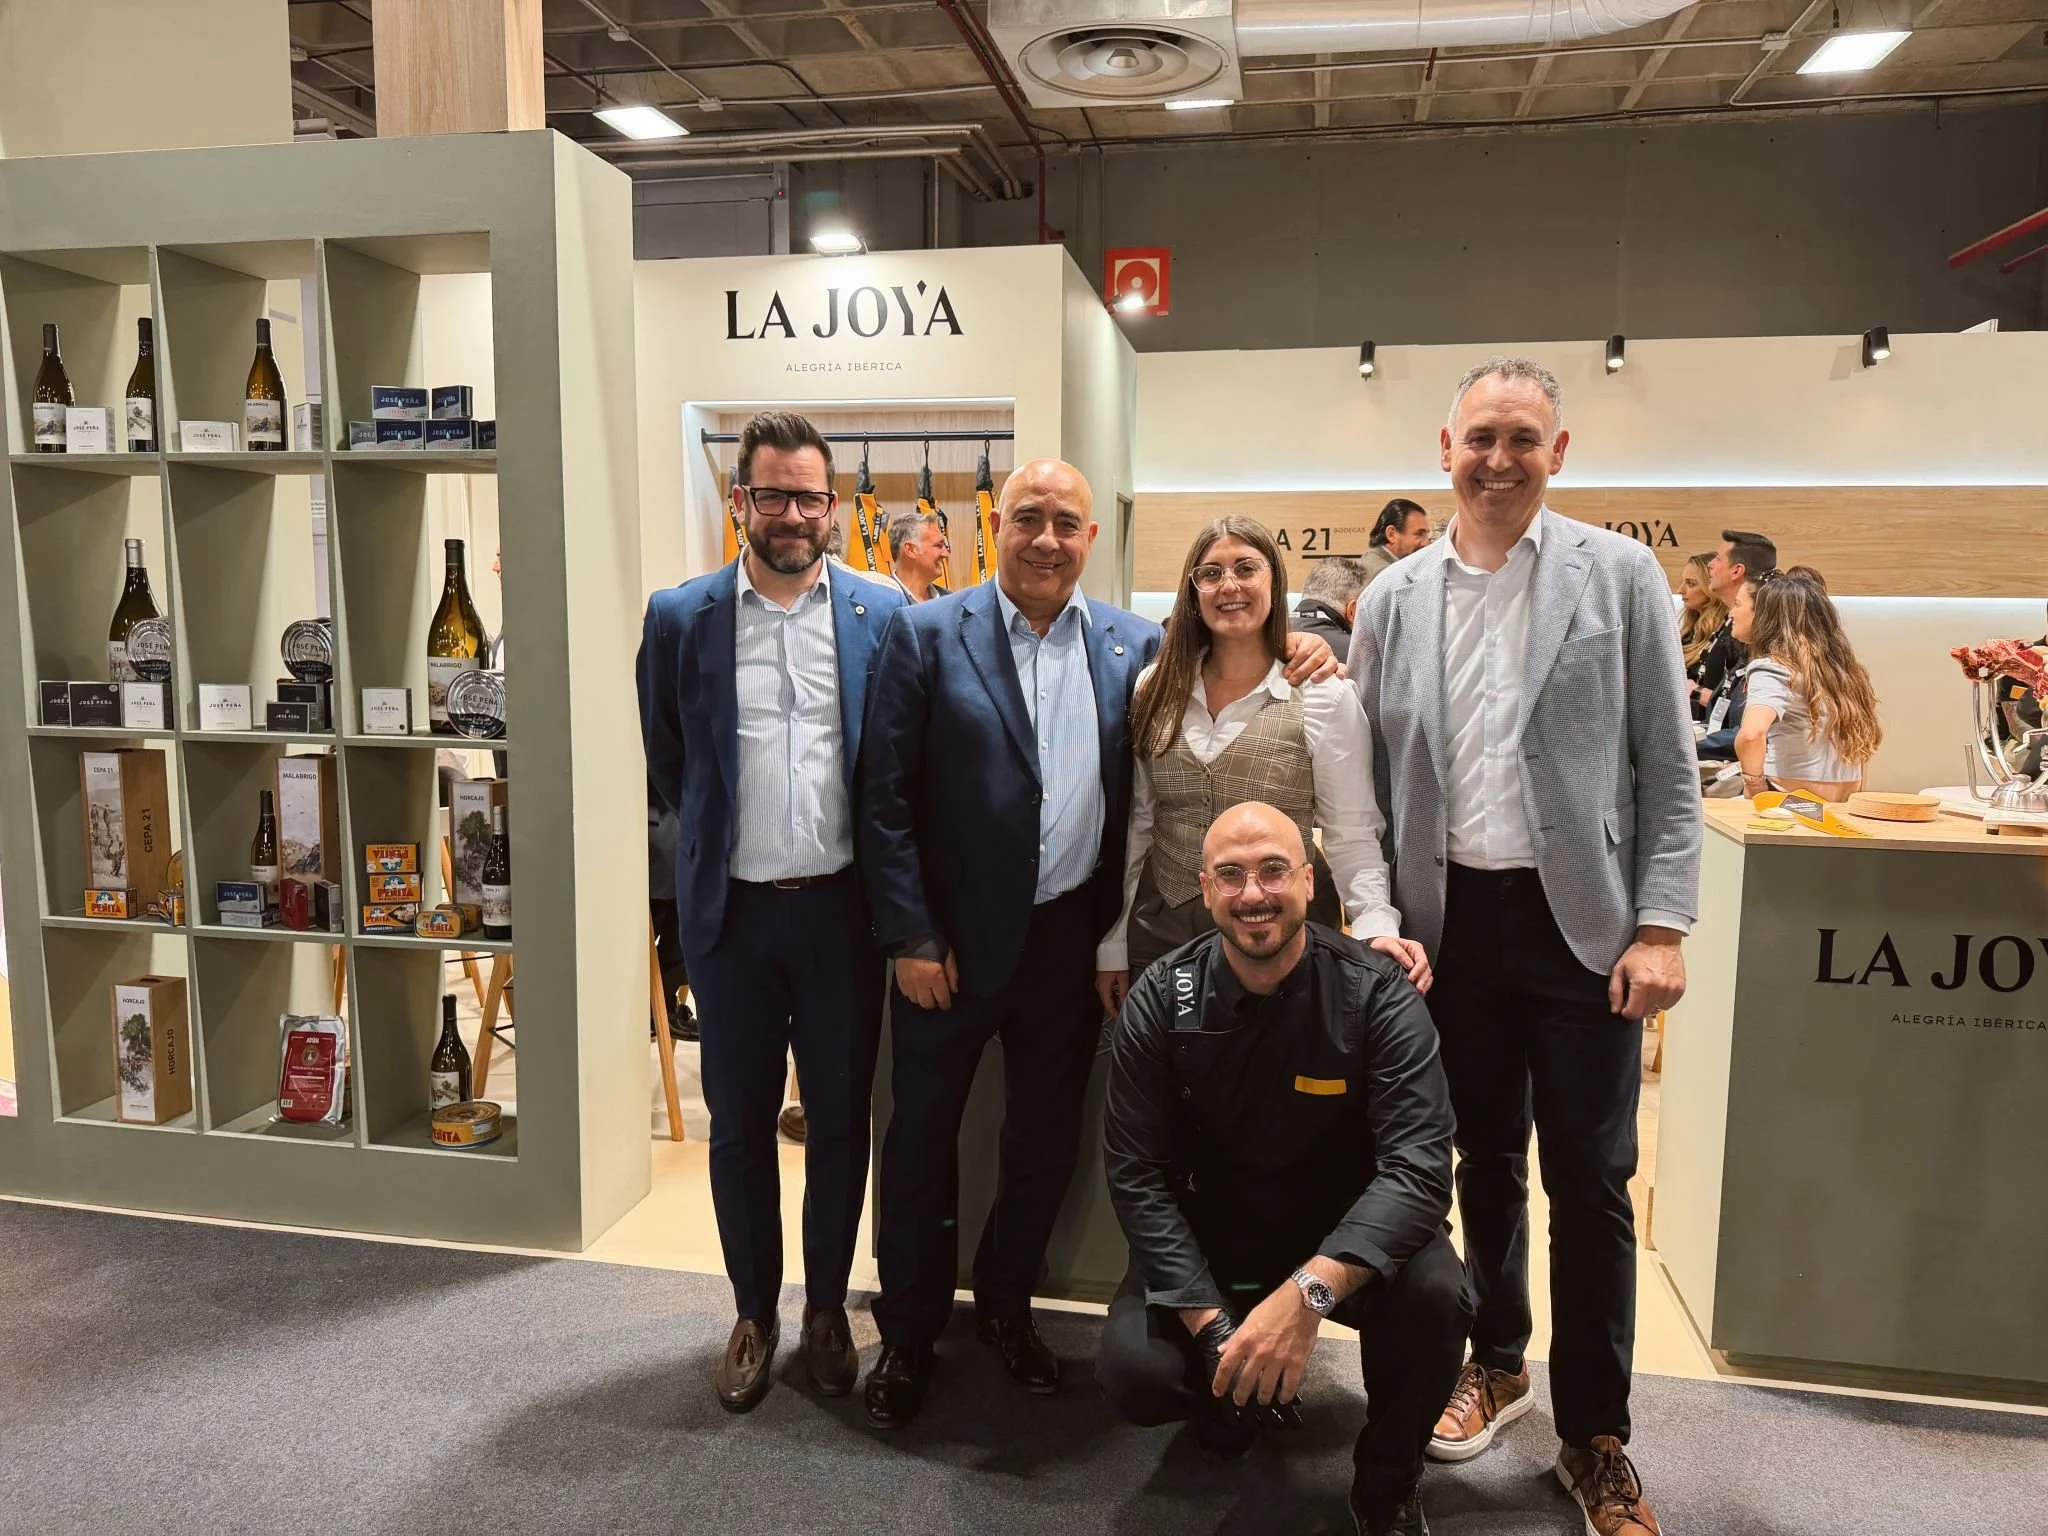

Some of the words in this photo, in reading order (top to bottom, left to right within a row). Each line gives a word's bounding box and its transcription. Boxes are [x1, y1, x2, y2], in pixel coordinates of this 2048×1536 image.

[724, 289, 798, 340] LA
[812, 279, 965, 339] JOYA
[785, 361, 843, 373] ALEGRÍA
[847, 360, 903, 372] IBÉRICA
[858, 508, 867, 527] JOYA
[862, 525, 869, 536] LA
[1301, 527, 1331, 551] 21
[1333, 527, 1366, 535] BODEGAS
[282, 772, 317, 780] MALABRIGO
[142, 808, 152, 821] 21
[143, 823, 153, 853] CEPA
[377, 887, 414, 898] PEÑITA
[91, 902, 122, 914] PEÑITA
[1813, 928, 1913, 988] LA
[1930, 934, 2048, 993] JO
[1175, 968, 1196, 1017] JOYA
[1890, 1013, 1967, 1027] ALEGRÍA
[1973, 1016, 2047, 1031] IBÉRICA
[167, 1028, 176, 1076] HORCAJO
[432, 1127, 462, 1143] EÑITA
